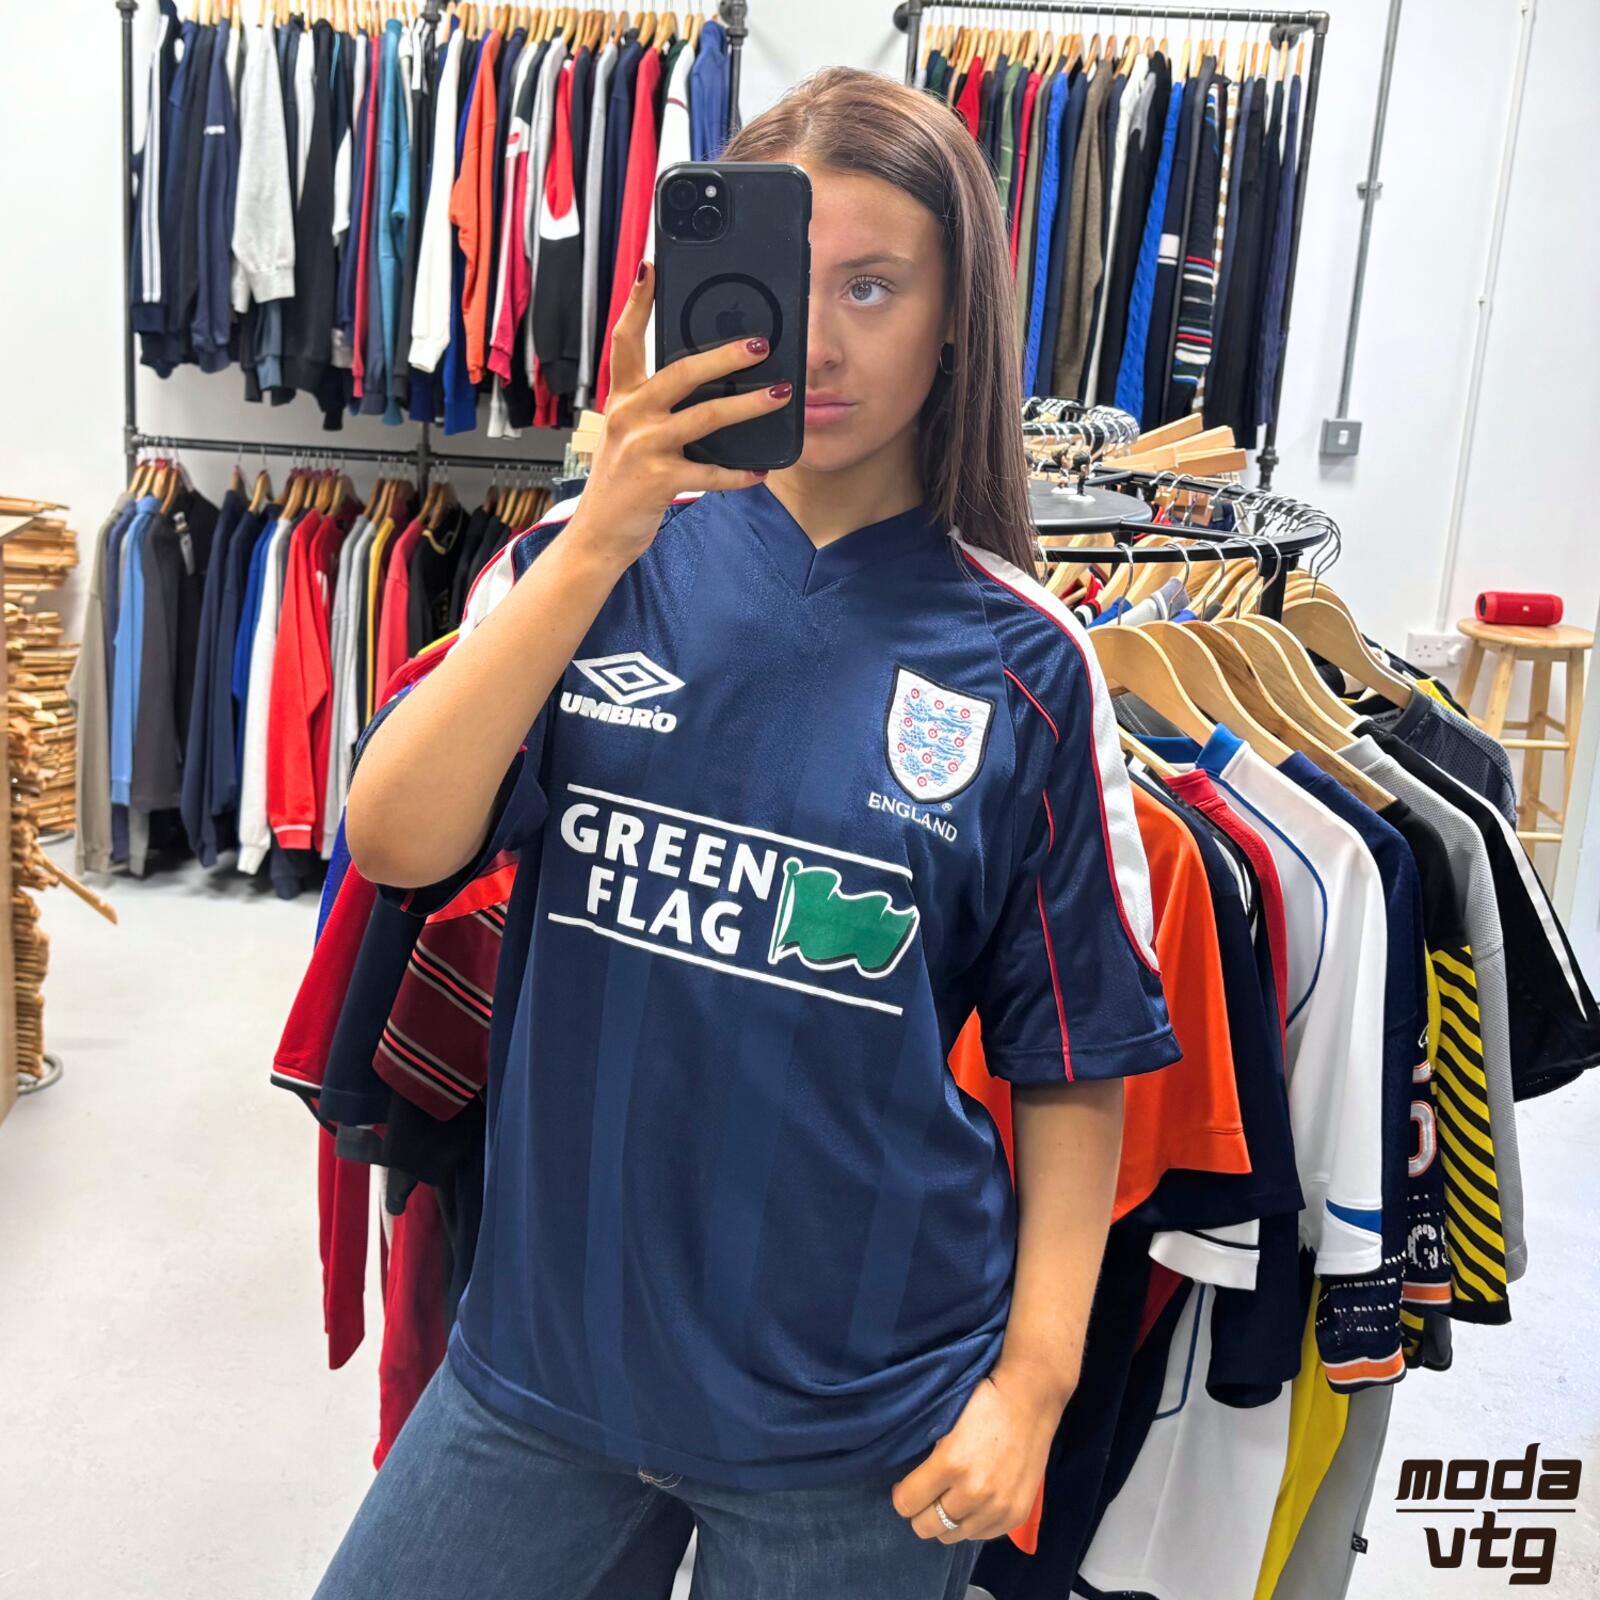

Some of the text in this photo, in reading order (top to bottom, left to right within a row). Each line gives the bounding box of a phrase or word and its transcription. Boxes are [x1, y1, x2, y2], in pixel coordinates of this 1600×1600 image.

[560, 691, 678, 733] UMBRO
[560, 803, 778, 901] GREEN
[867, 791, 958, 843] ENGLAND
[586, 865, 743, 955] FLAG
